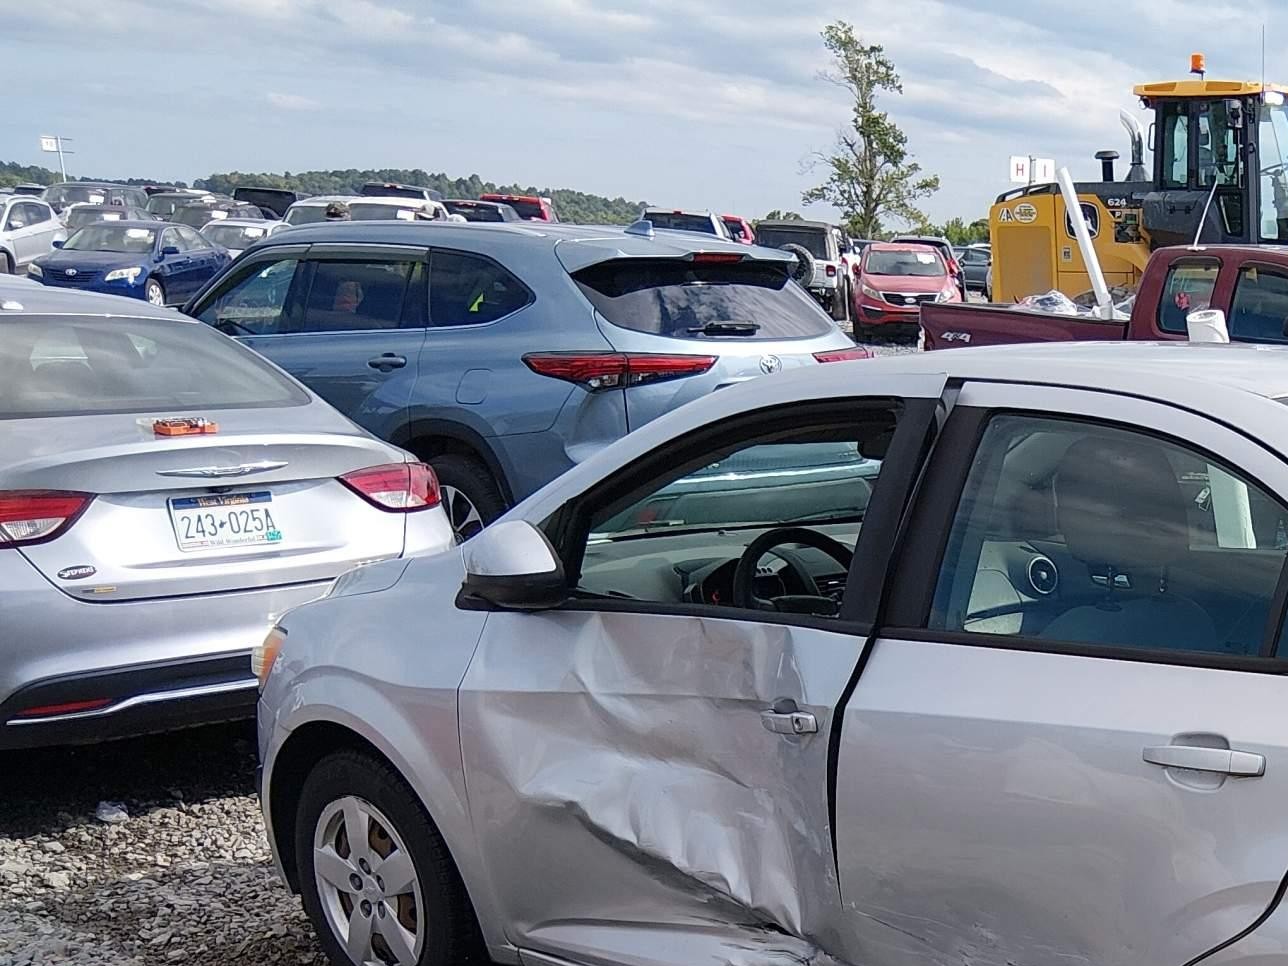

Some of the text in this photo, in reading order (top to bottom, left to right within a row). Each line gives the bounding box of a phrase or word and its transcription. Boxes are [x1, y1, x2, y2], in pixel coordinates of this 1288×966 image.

[1015, 162, 1025, 177] H
[1107, 197, 1127, 207] 624
[180, 507, 276, 539] 243 025A
